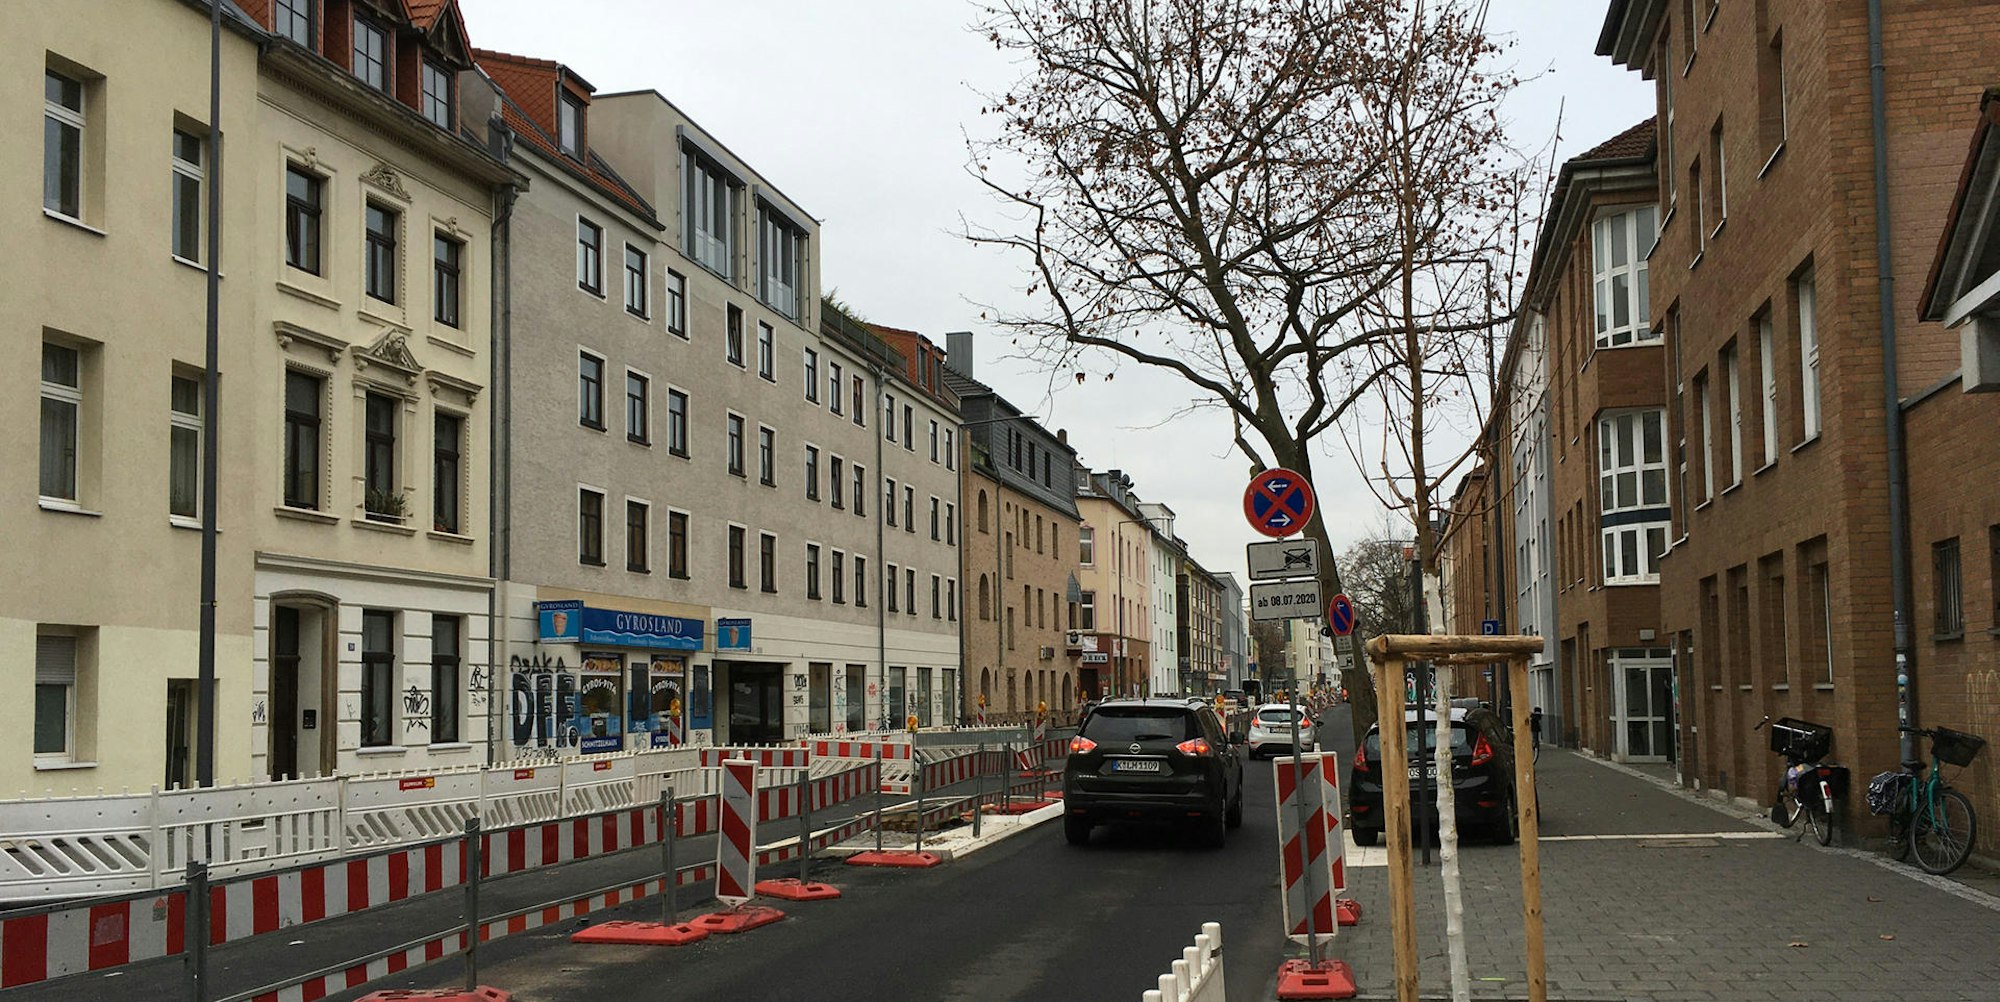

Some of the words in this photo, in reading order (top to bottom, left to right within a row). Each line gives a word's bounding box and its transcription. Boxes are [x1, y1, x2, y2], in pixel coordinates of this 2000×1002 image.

[1257, 596, 1269, 607] ab
[1270, 593, 1316, 607] 08.07.2020
[616, 613, 683, 635] GYROSLAND
[582, 678, 617, 695] GYROS-PITA
[652, 680, 680, 695] GYROS-PITA
